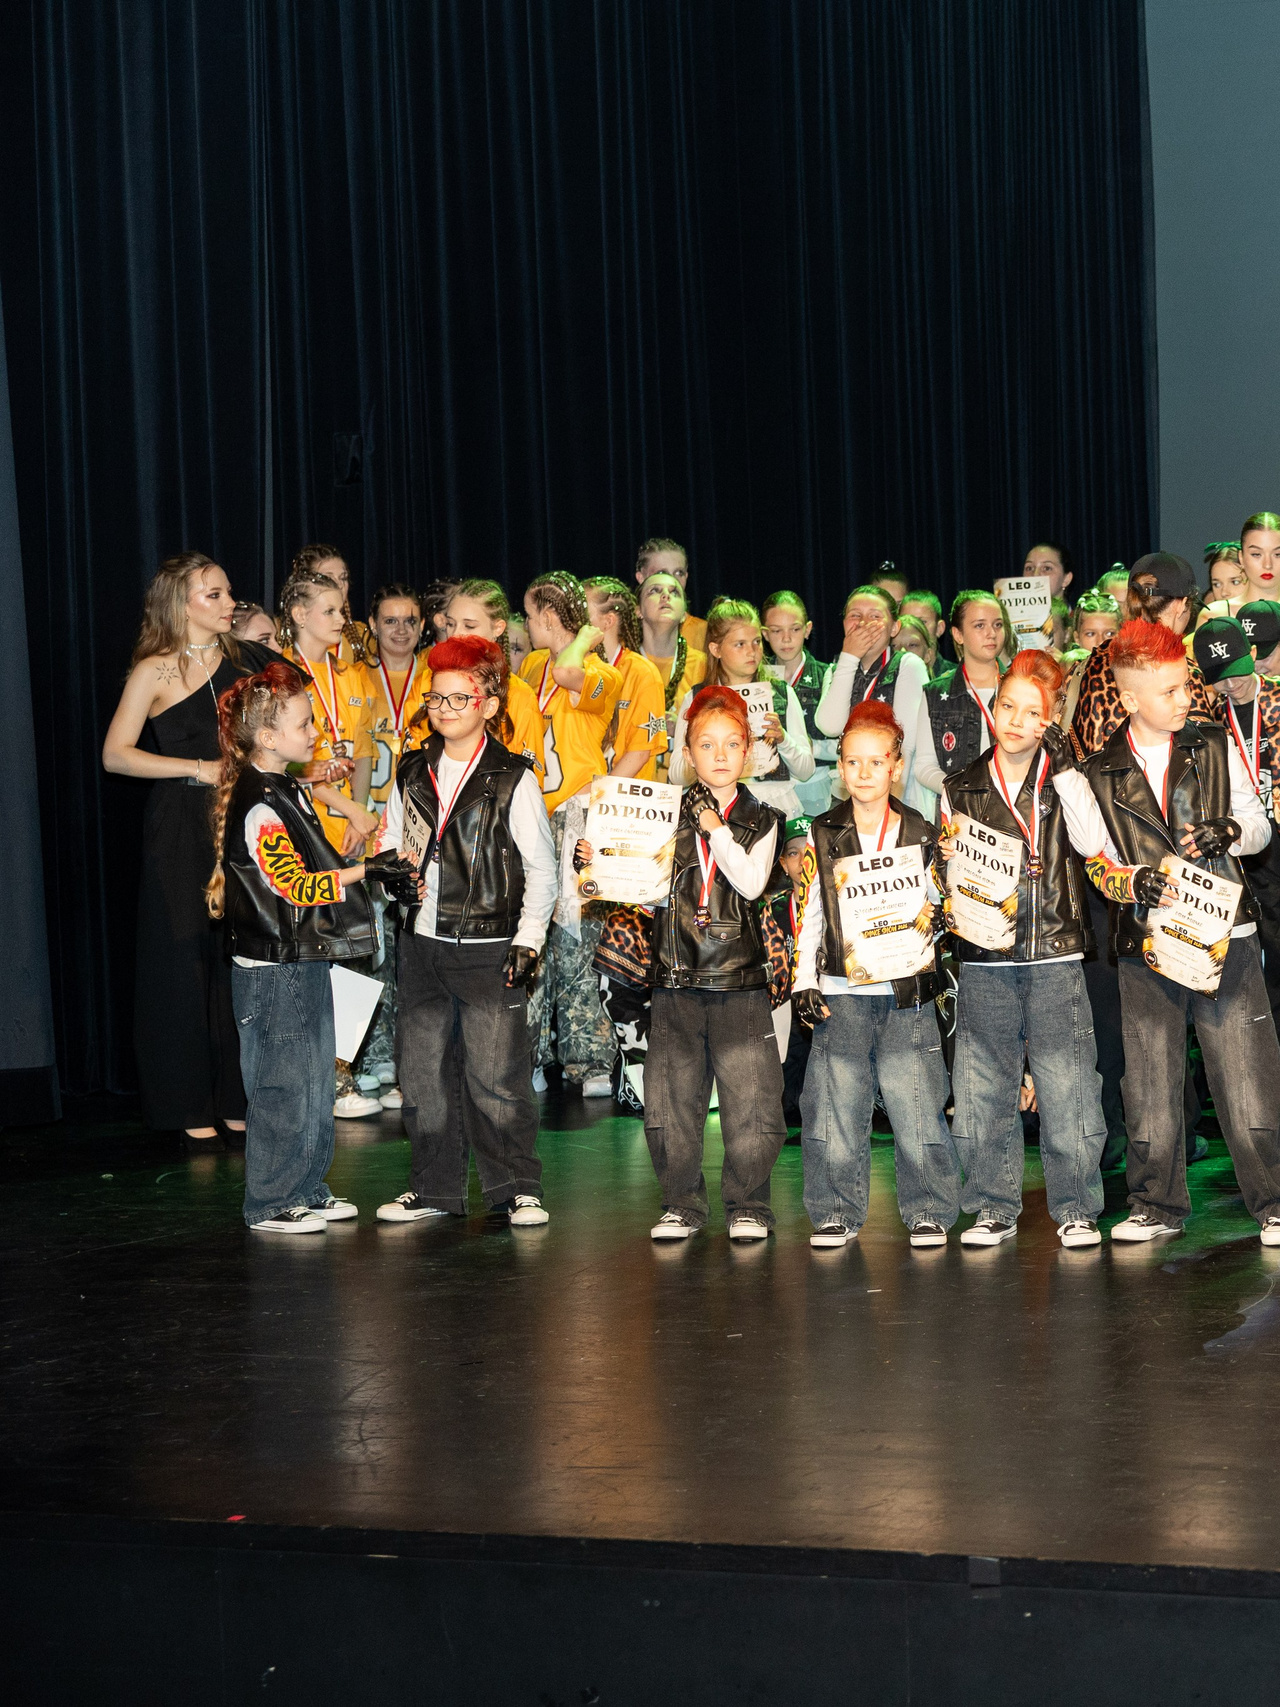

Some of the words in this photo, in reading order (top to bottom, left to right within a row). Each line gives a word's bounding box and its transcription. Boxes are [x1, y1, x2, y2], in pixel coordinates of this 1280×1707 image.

[1008, 582, 1031, 590] LEO
[617, 783, 653, 797] LEO
[598, 803, 674, 823] DYPLOM
[969, 824, 997, 847] LEO
[859, 856, 894, 872] LEO
[955, 839, 1015, 877] DYPLOM
[291, 874, 335, 903] BAD
[845, 874, 921, 899] DYPLOM
[1181, 867, 1213, 890] LEO
